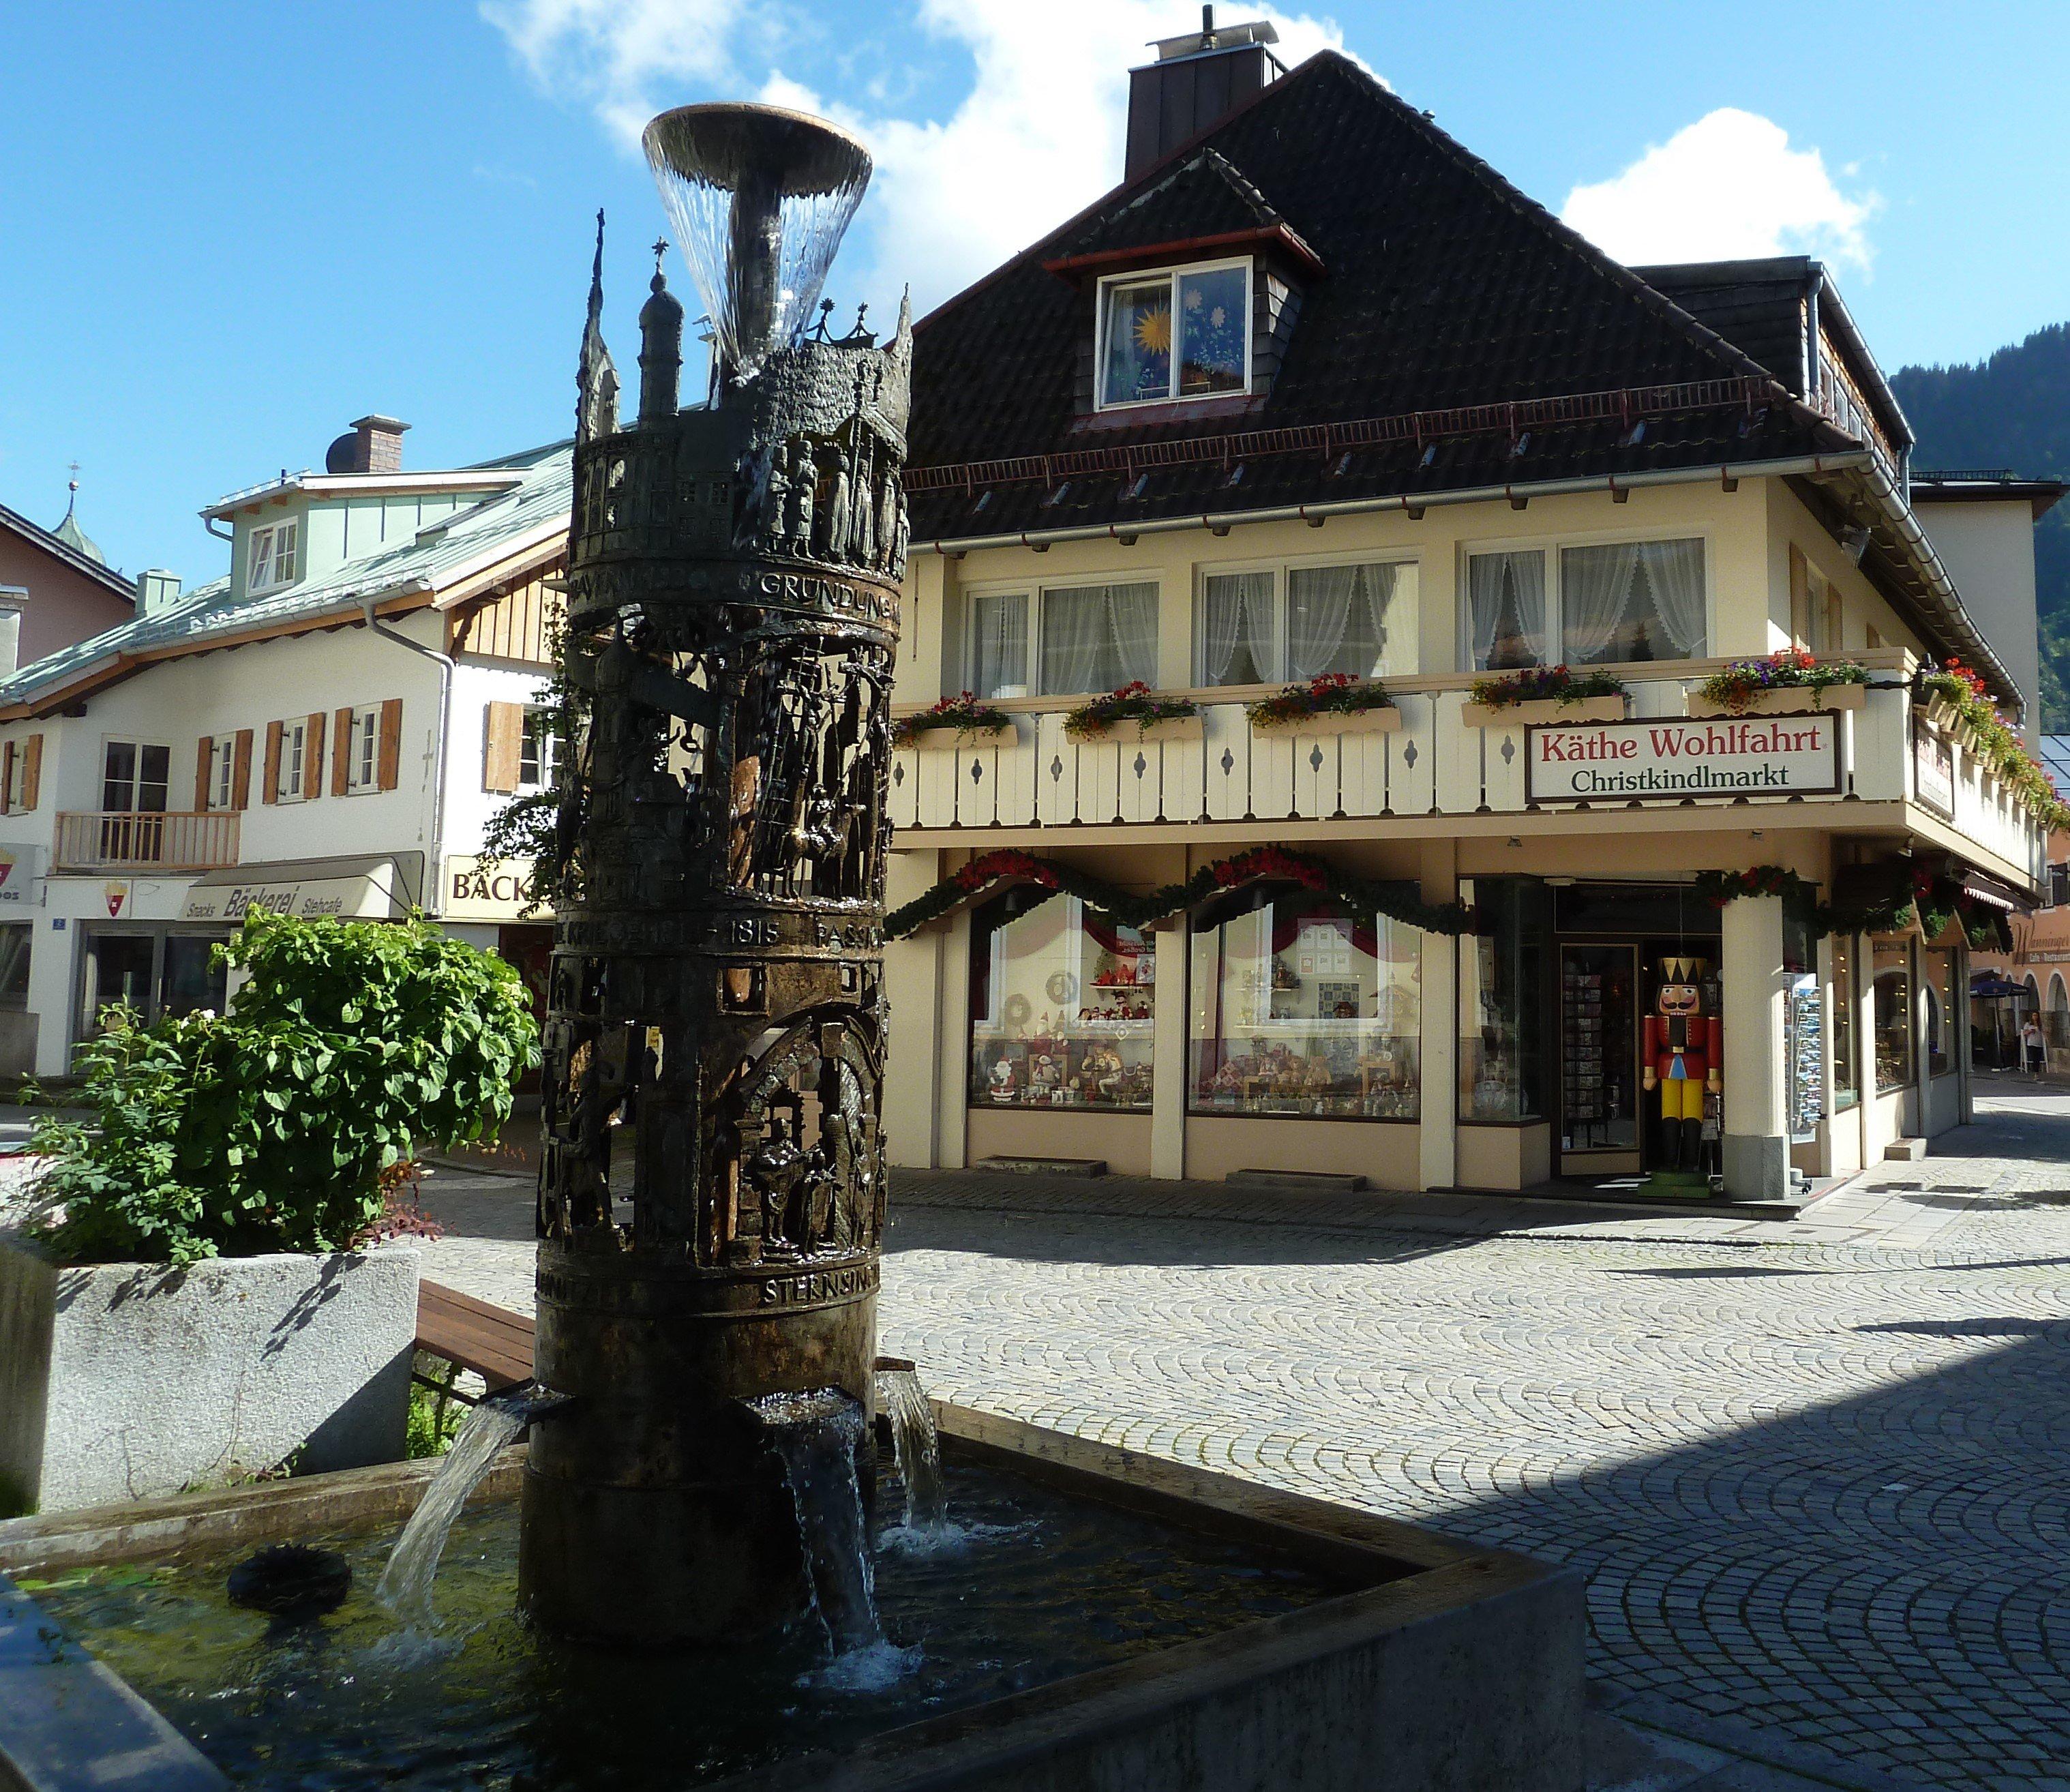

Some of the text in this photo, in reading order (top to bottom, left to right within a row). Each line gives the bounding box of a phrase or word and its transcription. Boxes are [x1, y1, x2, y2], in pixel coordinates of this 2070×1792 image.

[1541, 723, 1821, 762] Käthe Wohlfahrt
[1571, 763, 1790, 792] Christkindlmarkt
[732, 919, 780, 944] 1815
